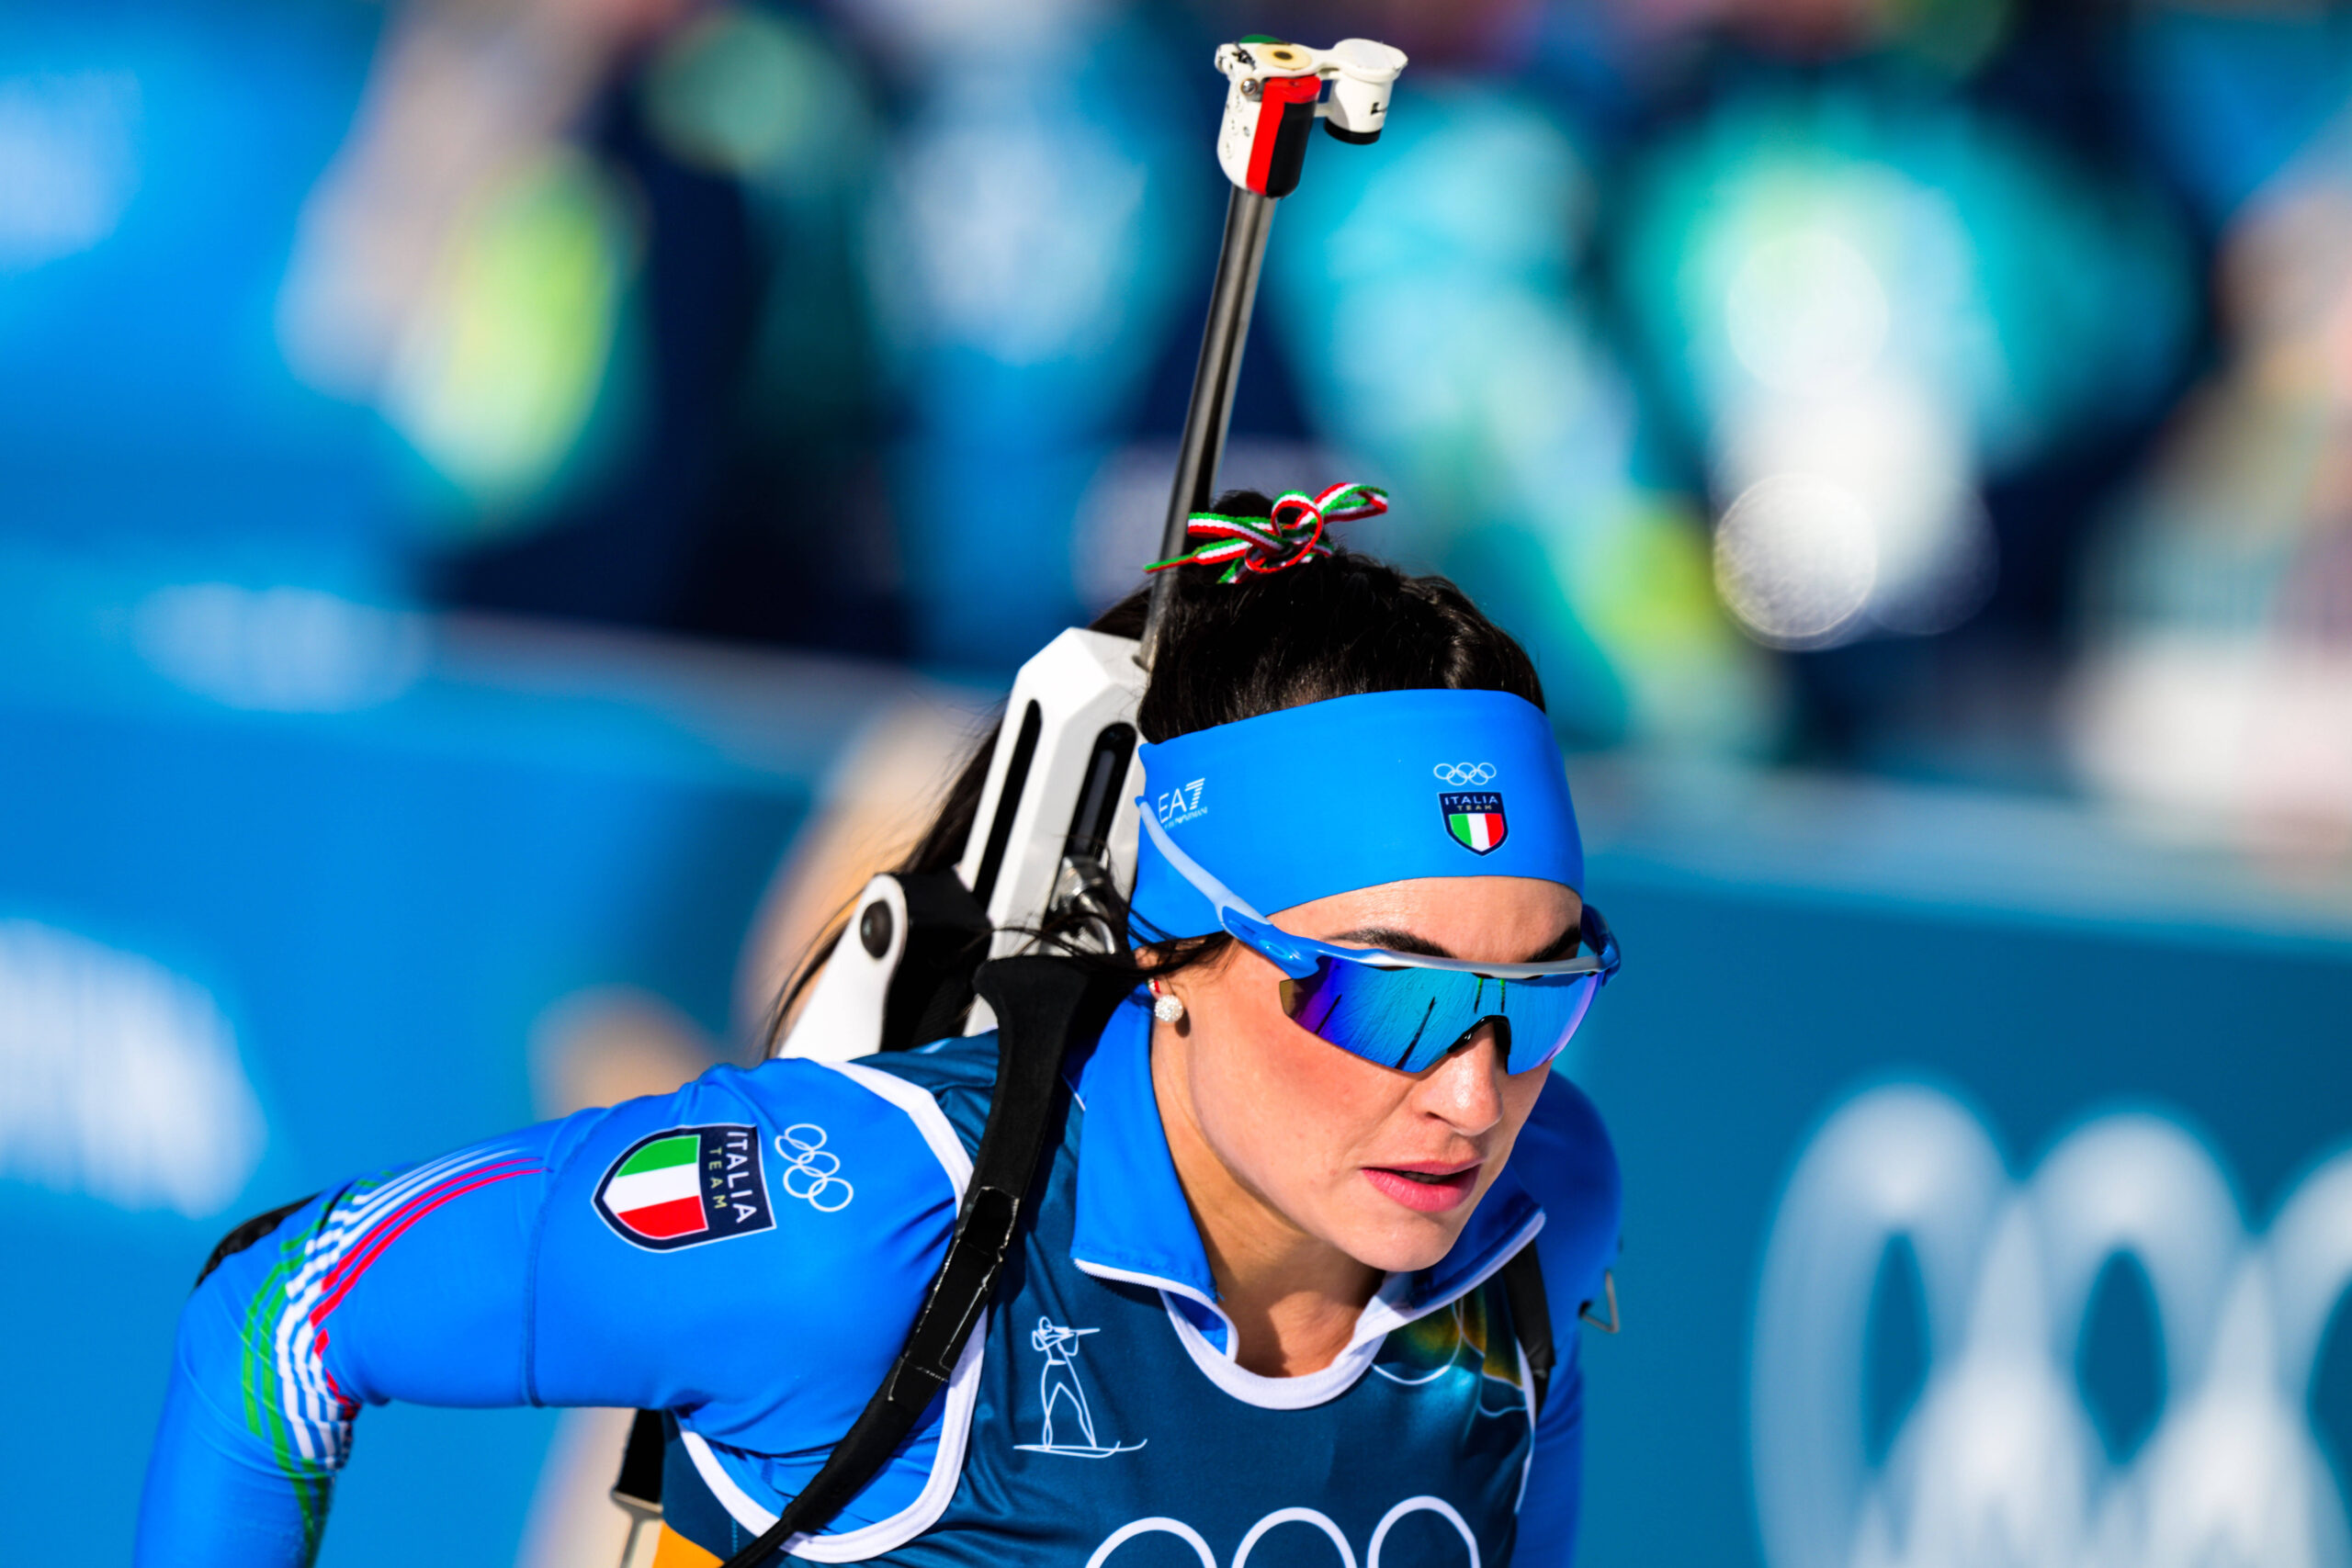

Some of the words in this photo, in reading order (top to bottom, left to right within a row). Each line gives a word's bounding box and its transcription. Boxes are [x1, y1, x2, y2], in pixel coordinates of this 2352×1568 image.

[1159, 777, 1205, 824] EA7
[1444, 795, 1498, 806] ITALIA
[708, 1146, 728, 1209] TEAM
[726, 1132, 757, 1223] ITALIA
